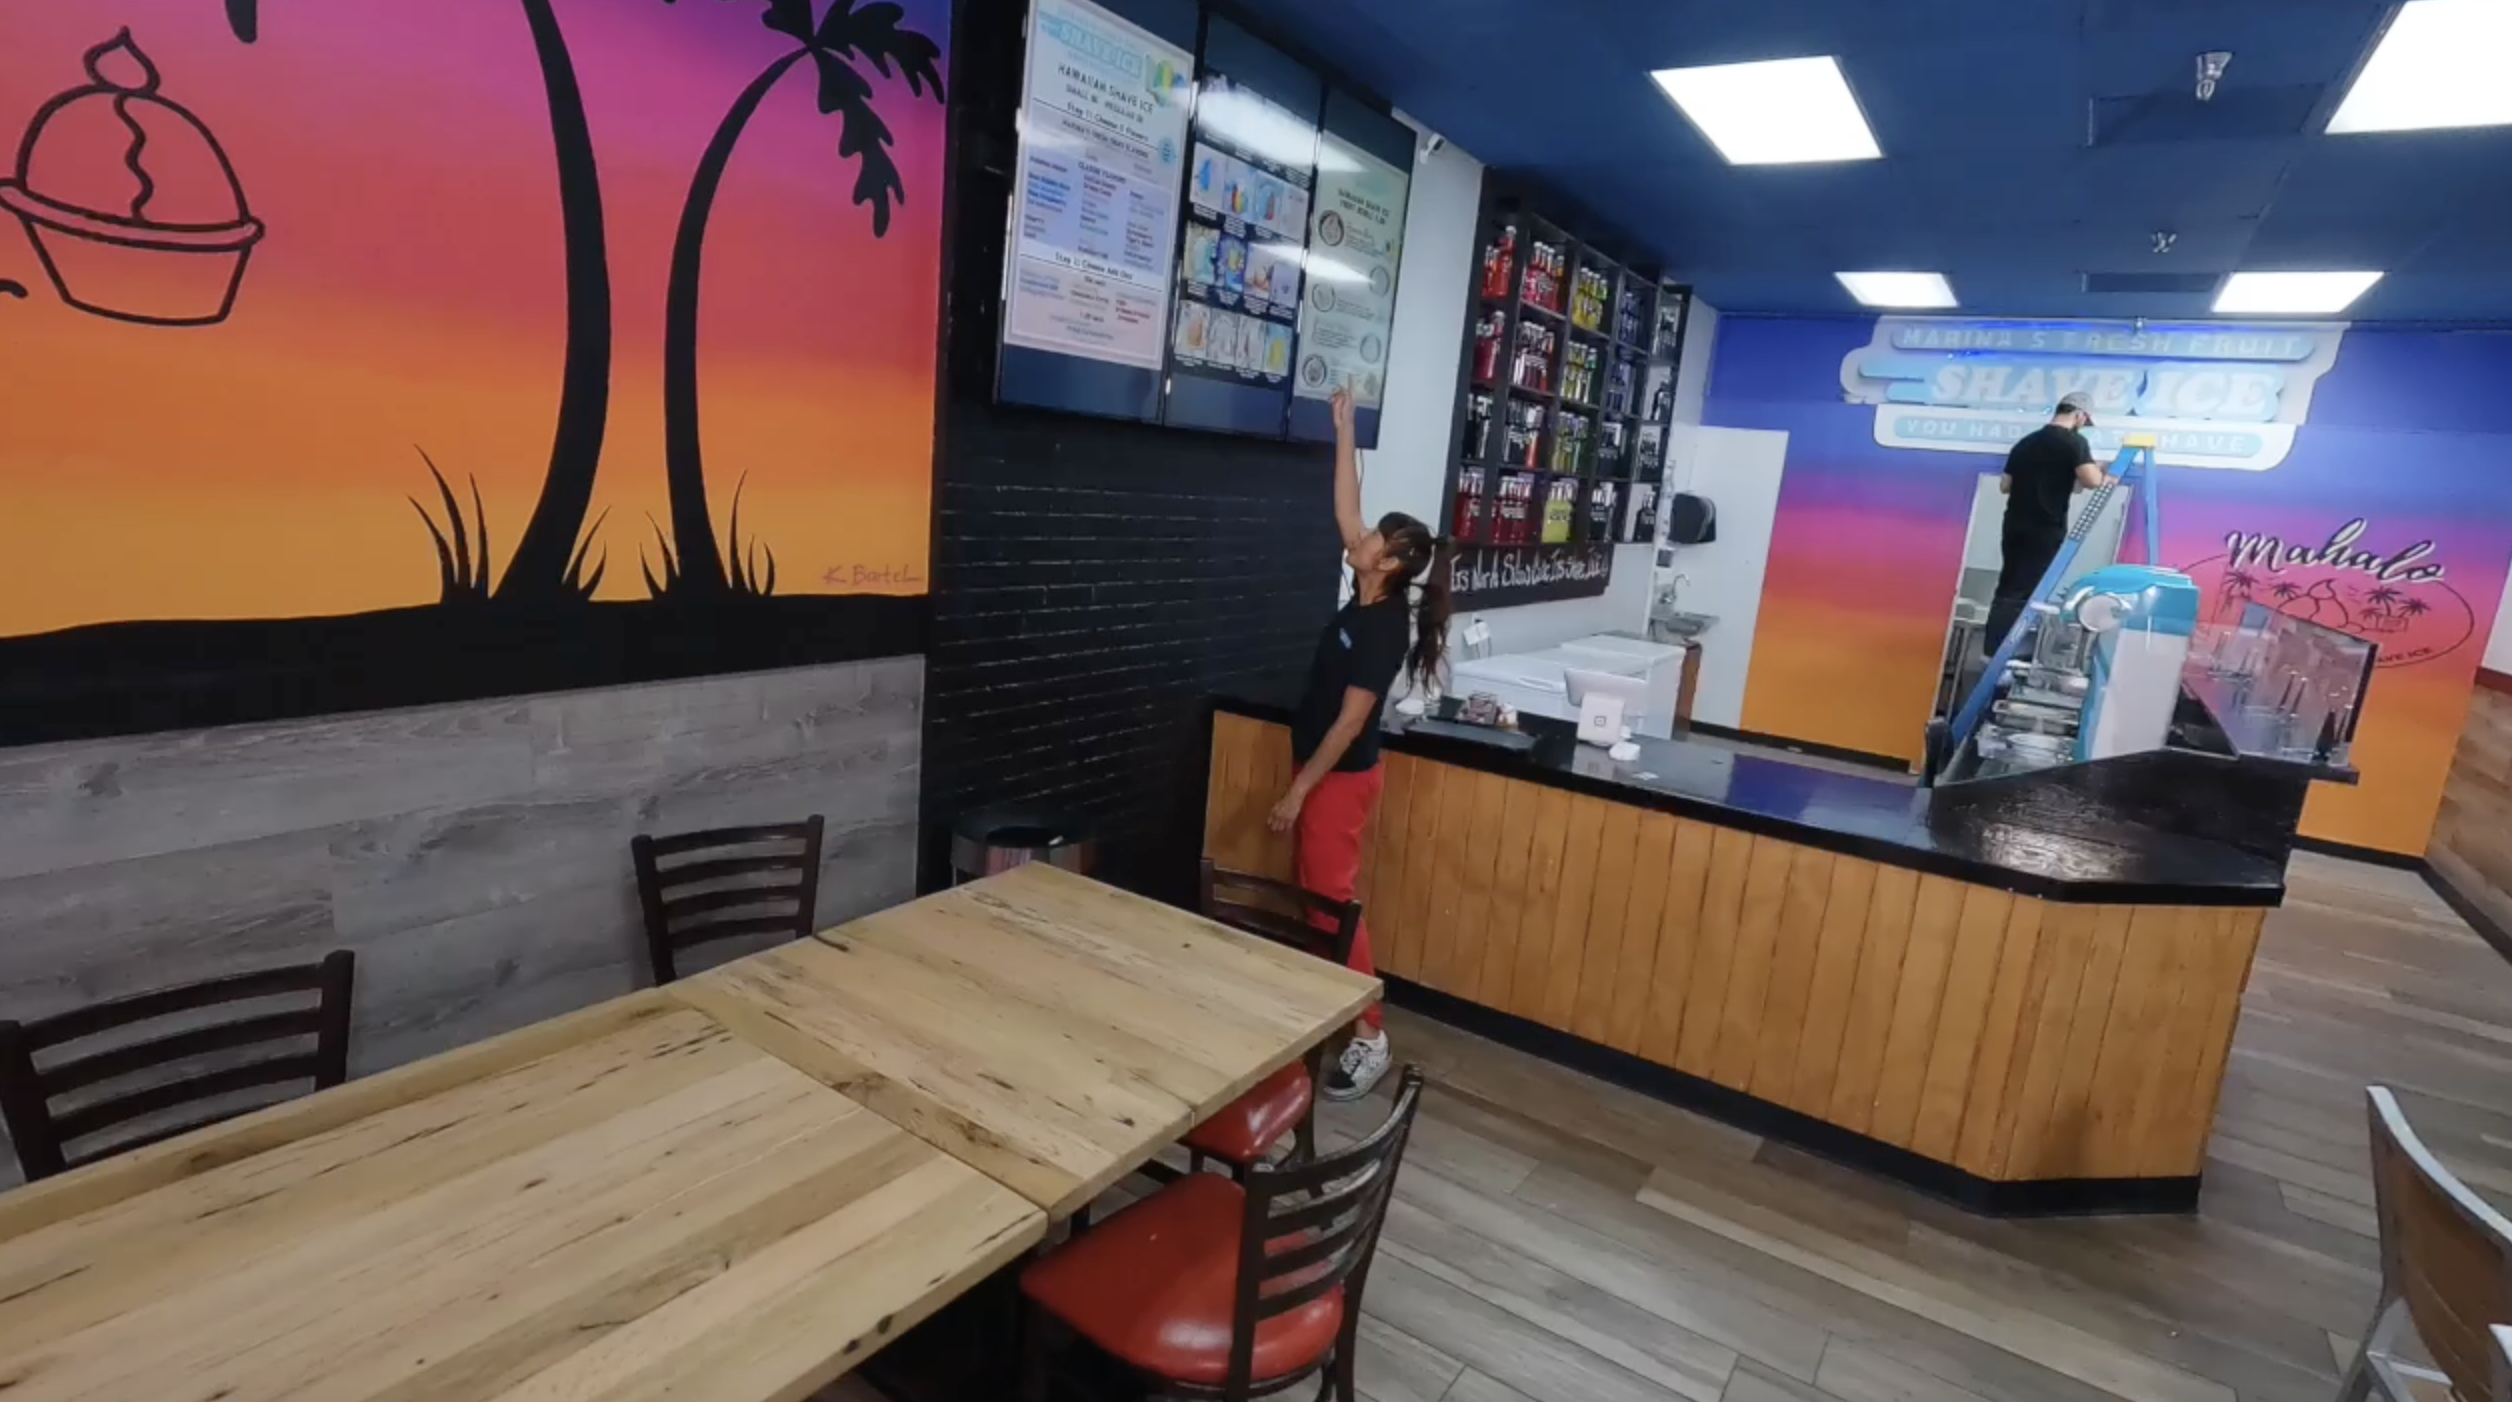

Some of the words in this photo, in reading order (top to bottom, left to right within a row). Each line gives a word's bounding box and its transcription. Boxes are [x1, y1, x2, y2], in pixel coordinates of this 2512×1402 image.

[1057, 62, 1106, 92] HAWAIIAN
[1109, 85, 1137, 107] SHAVE
[1139, 99, 1154, 115] ICE
[1902, 329, 2048, 348] MARINAS
[2063, 331, 2171, 352] FRESH
[2188, 333, 2301, 356] FRUIT
[1932, 365, 2135, 409] SHAVE
[2146, 370, 2278, 416] ICE
[1905, 419, 1957, 435] YOU
[1968, 423, 2022, 440] HAD
[2161, 432, 2247, 453] HAVE
[2224, 517, 2445, 582] Mahalo
